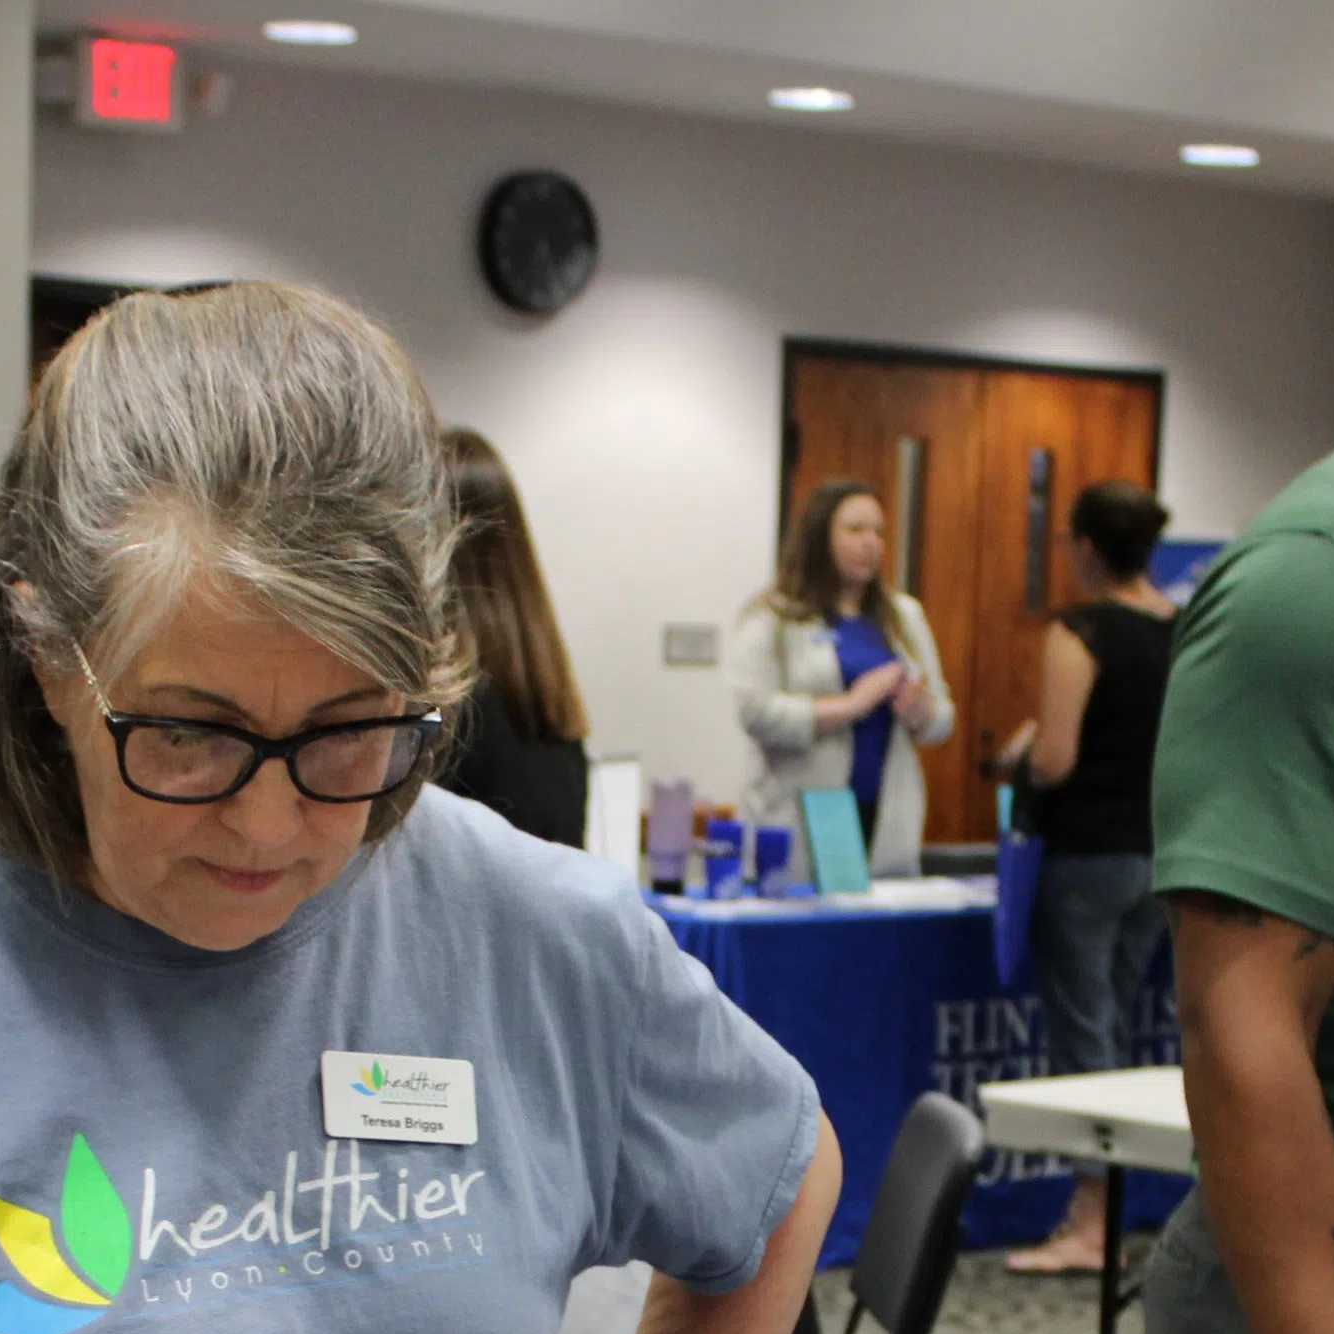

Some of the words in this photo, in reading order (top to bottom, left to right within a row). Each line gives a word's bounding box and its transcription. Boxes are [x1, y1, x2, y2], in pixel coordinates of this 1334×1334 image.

[933, 996, 1049, 1058] FLIN
[382, 1069, 452, 1092] healthier
[360, 1113, 402, 1129] Teresa
[404, 1116, 445, 1134] Briggs
[139, 1139, 485, 1261] healthier
[139, 1264, 263, 1304] Lyon
[302, 1231, 485, 1277] County
